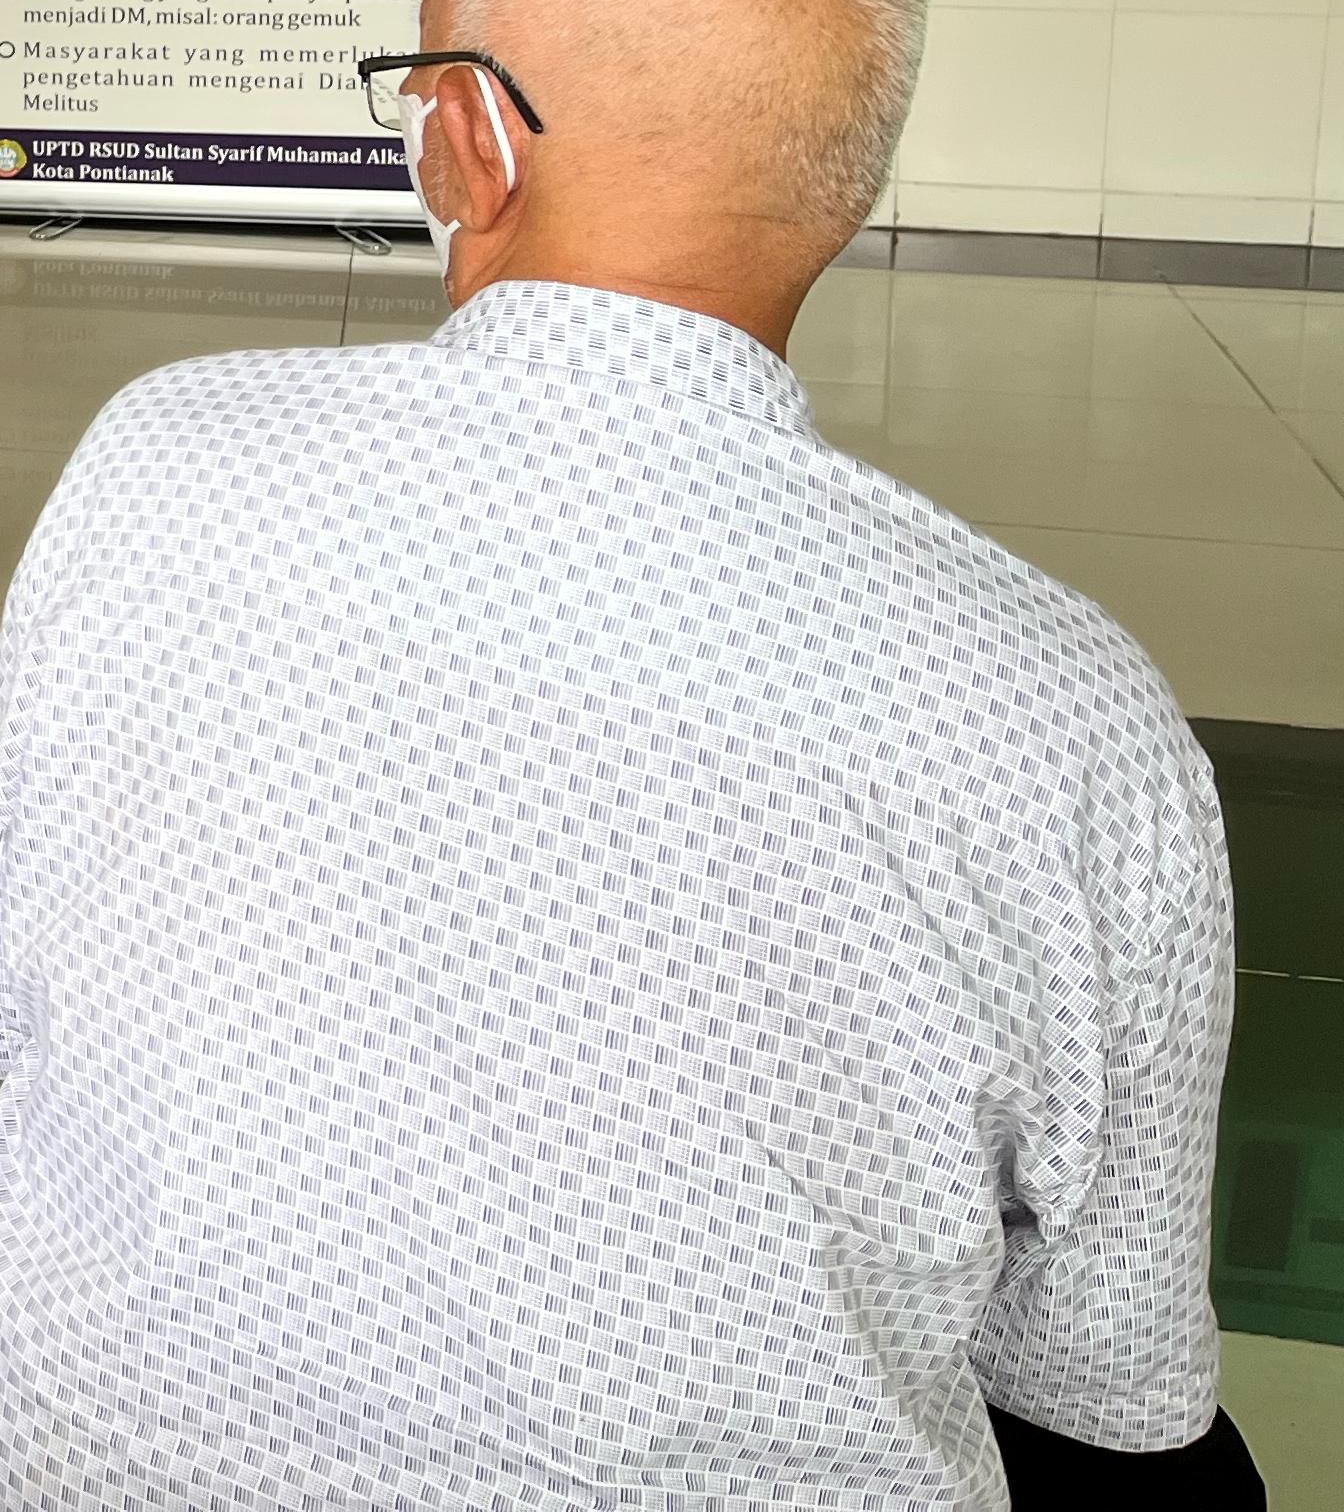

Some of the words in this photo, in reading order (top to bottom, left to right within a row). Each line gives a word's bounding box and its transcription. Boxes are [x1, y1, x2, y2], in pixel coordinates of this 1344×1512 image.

[24, 6, 105, 27] menjadi
[112, 7, 151, 26] DM,
[156, 7, 217, 24] misal:
[223, 13, 283, 30] orang
[288, 9, 360, 30] gemuk
[24, 42, 169, 63] Masyarakat
[184, 49, 243, 65] yang
[24, 69, 173, 89] pengetahuan
[189, 73, 302, 92] mengenai
[24, 94, 98, 111] Melitus
[33, 141, 84, 156] UPTD
[90, 142, 140, 158] RSUD
[145, 144, 203, 160] Sultan
[208, 145, 264, 164] Syarif
[268, 146, 361, 163] Muhamad
[367, 146, 408, 166] Alka
[33, 163, 73, 178] Kota
[80, 165, 173, 181] Pontianak
